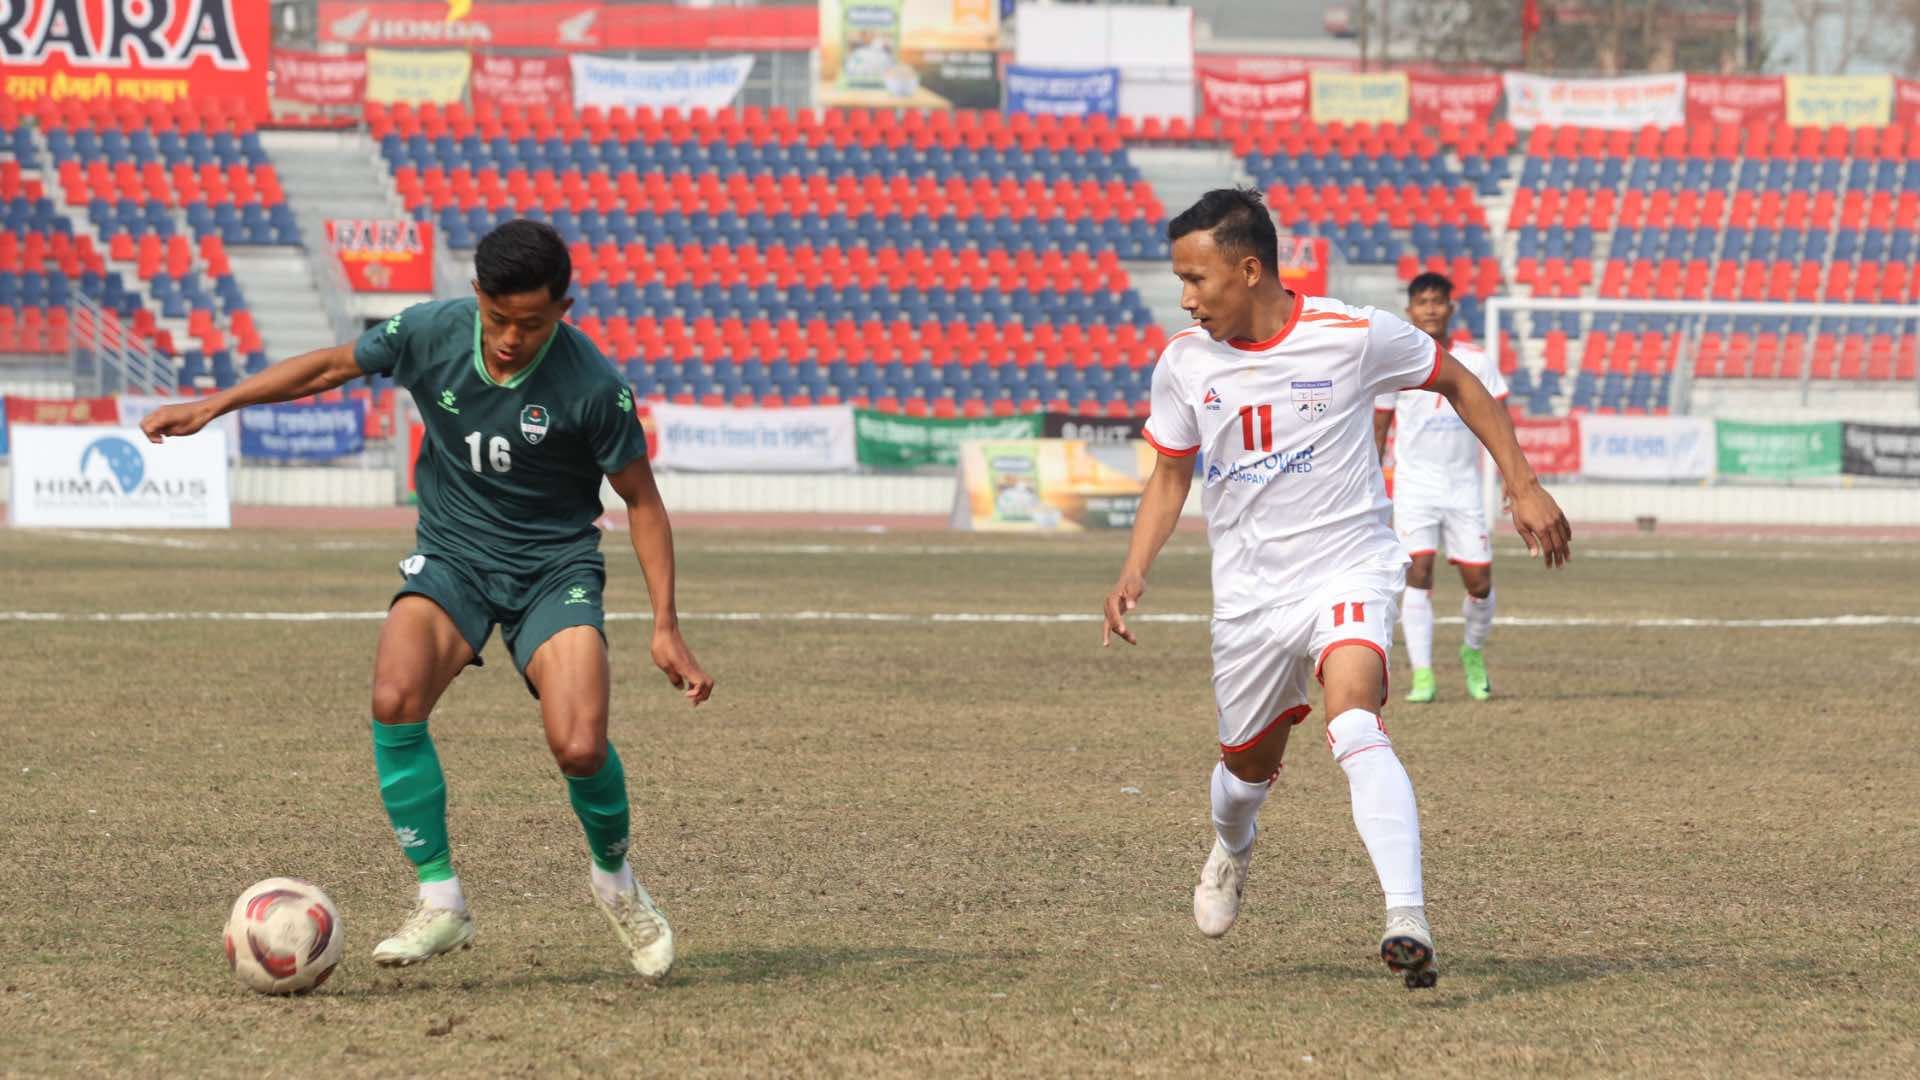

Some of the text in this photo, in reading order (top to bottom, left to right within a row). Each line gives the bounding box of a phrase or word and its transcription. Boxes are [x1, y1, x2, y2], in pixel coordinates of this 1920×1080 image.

[368, 19, 491, 42] HONDA
[334, 221, 423, 253] RARA
[1239, 404, 1273, 452] 11
[465, 431, 511, 472] 16
[1332, 601, 1365, 627] 11
